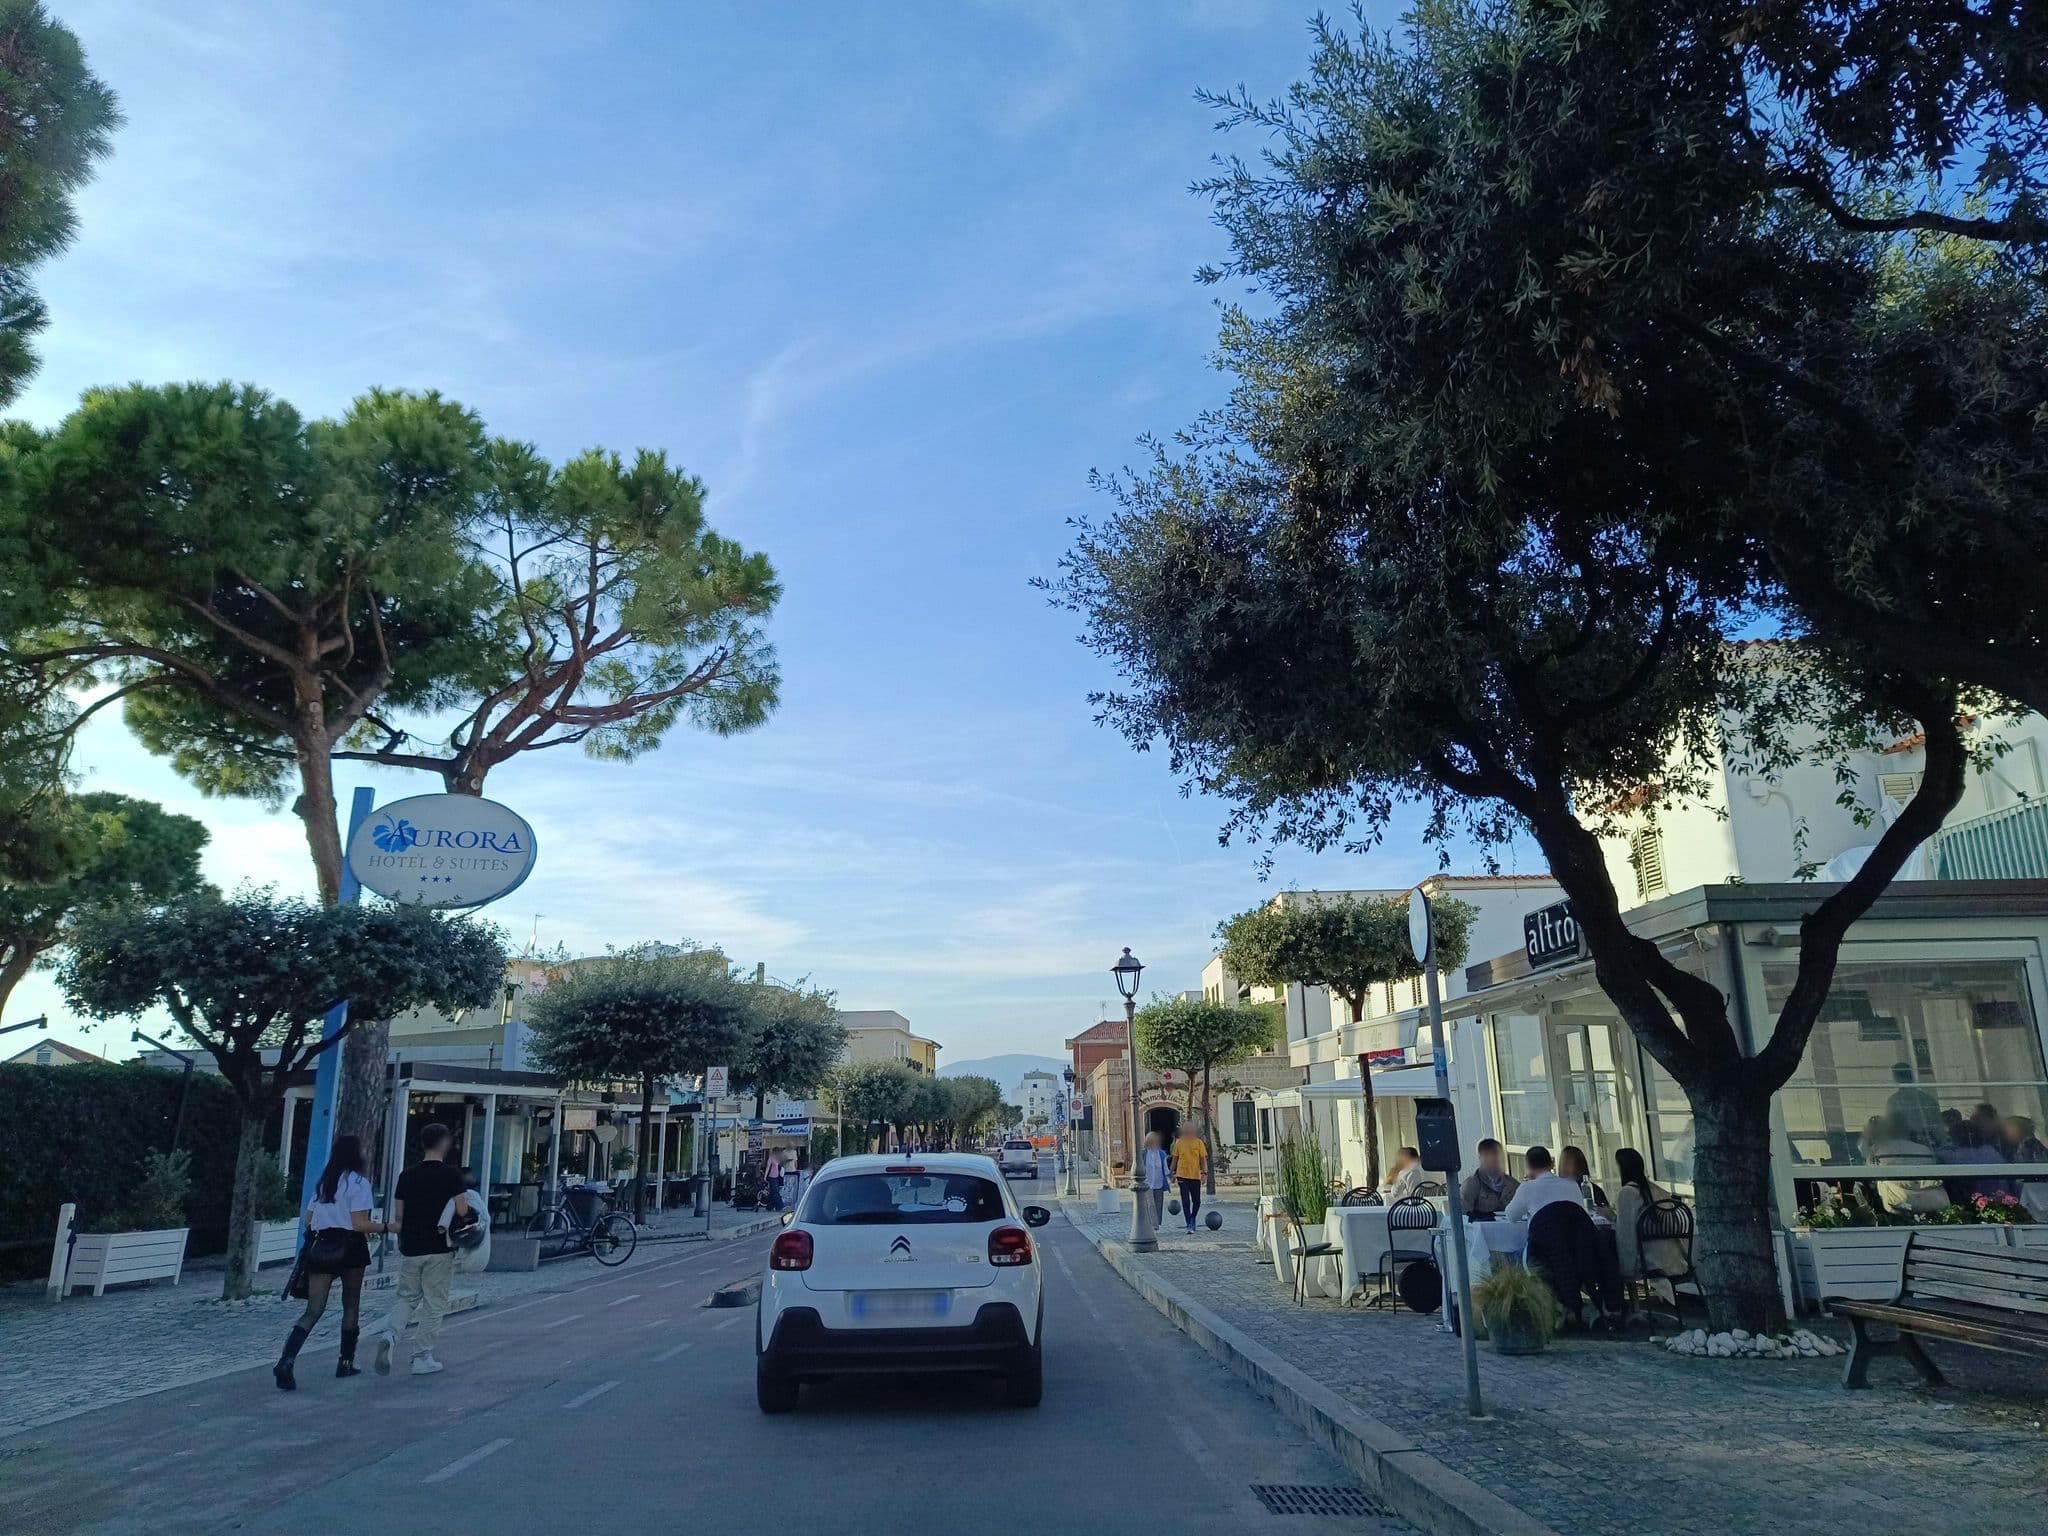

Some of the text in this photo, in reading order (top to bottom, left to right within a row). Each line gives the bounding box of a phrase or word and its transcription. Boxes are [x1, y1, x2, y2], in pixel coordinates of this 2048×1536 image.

[385, 821, 527, 853] AURORA
[368, 855, 510, 871] HOTEL & SUITES
